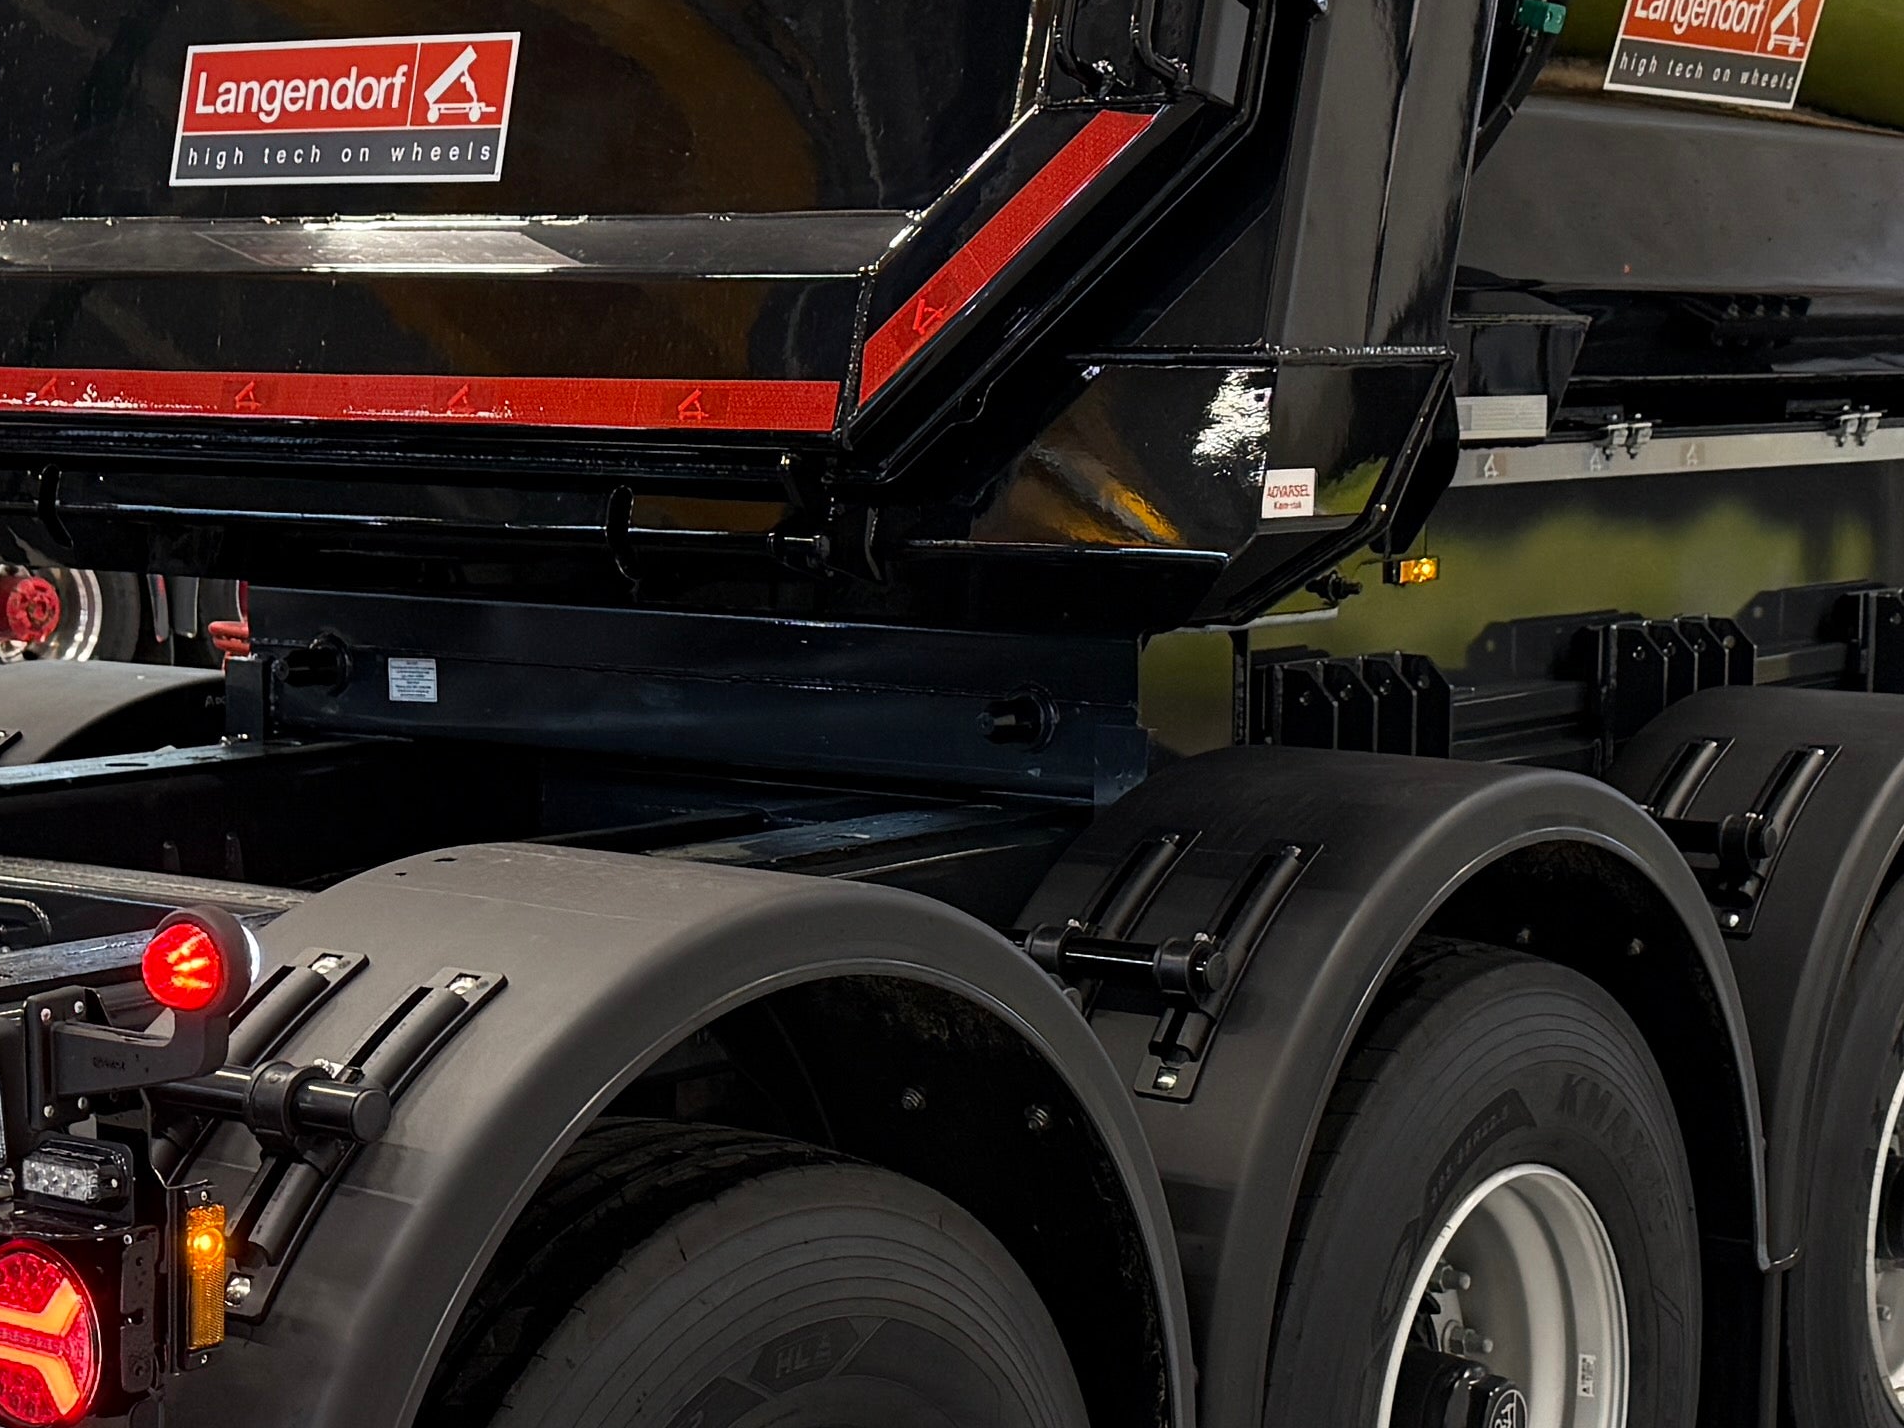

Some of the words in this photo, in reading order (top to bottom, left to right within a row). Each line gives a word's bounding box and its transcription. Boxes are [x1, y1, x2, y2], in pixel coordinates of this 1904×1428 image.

[1619, 52, 1658, 77] high
[1667, 59, 1703, 79] tech
[1712, 67, 1730, 83] on
[1740, 69, 1795, 90] wheels
[195, 64, 409, 124] Langendorf
[187, 147, 245, 170] high
[263, 145, 321, 164] tech
[341, 145, 370, 163] on
[391, 141, 492, 162] wheels
